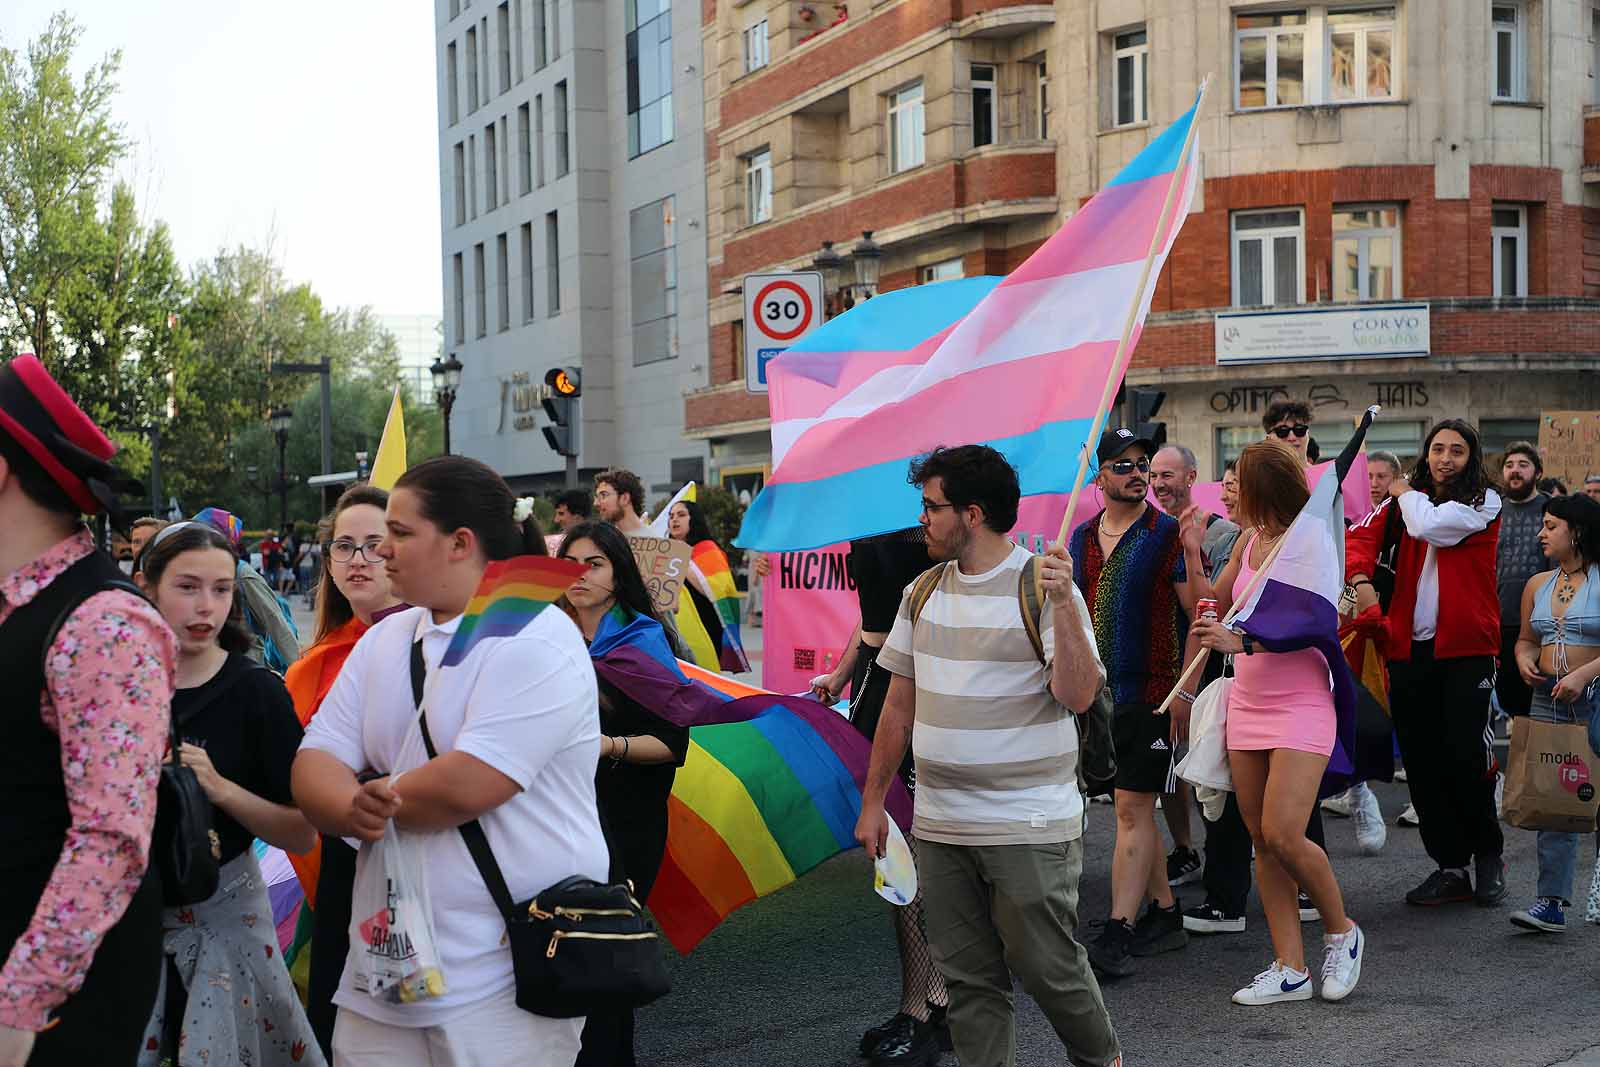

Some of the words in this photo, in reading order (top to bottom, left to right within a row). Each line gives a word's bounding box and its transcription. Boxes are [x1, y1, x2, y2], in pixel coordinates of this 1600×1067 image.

[766, 301, 799, 320] 30
[1352, 316, 1419, 331] CORVO
[1540, 752, 1580, 765] moda
